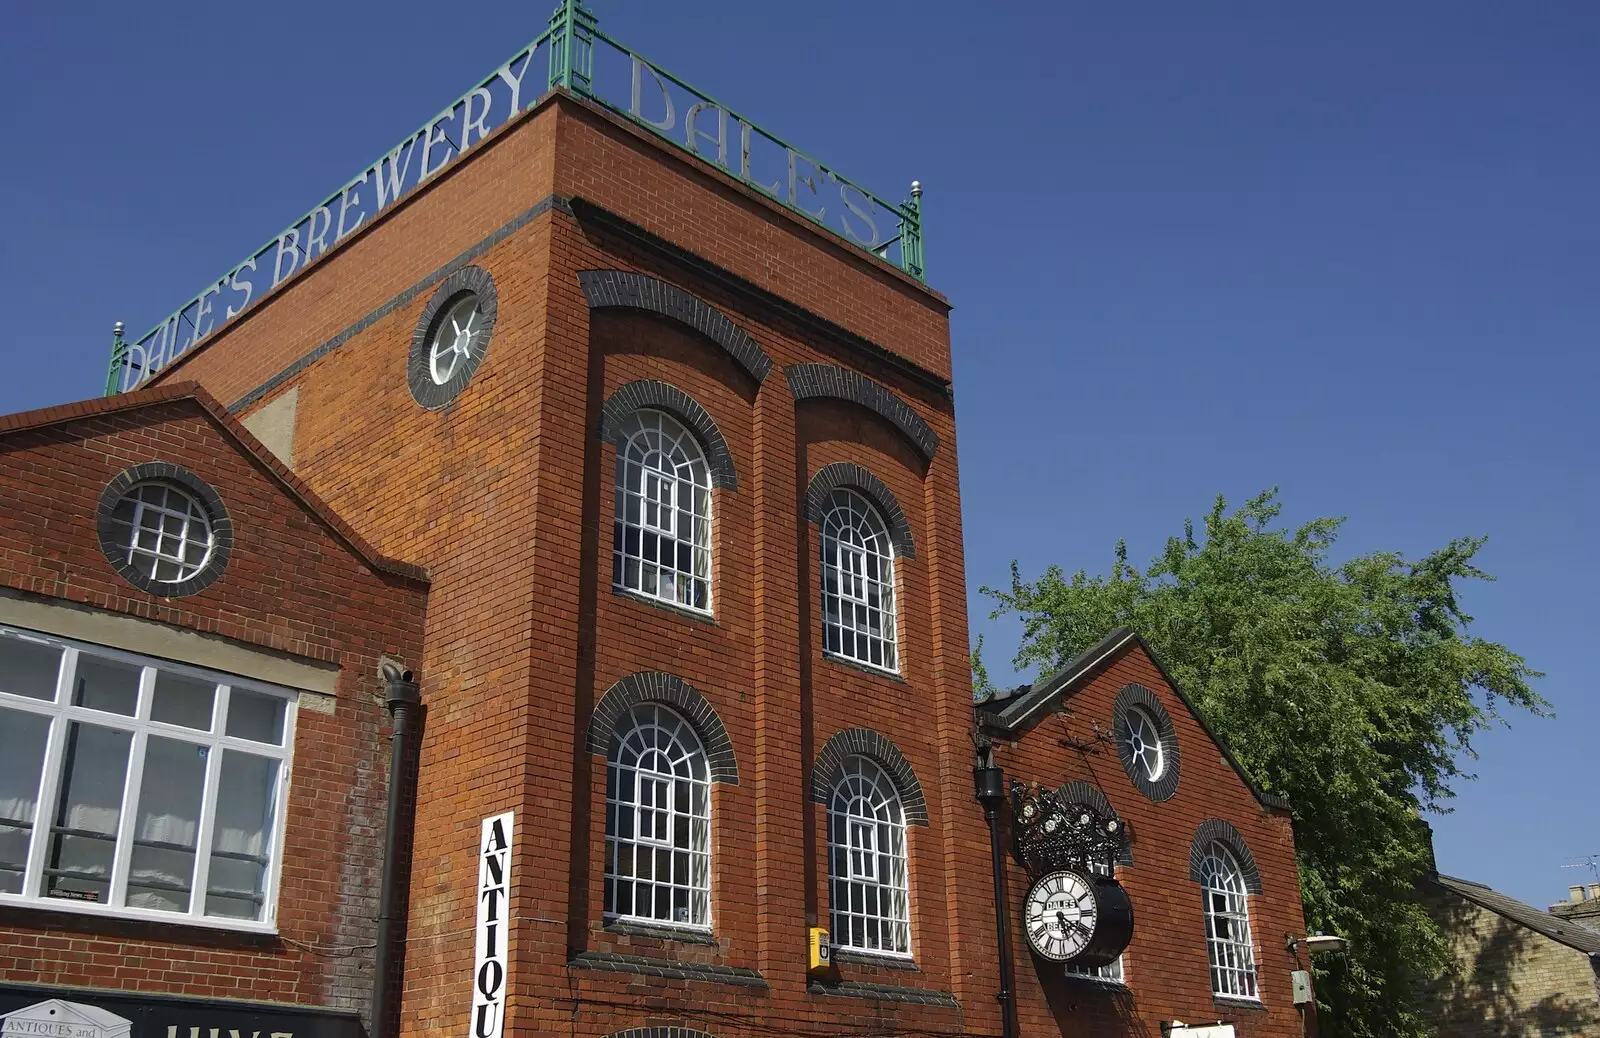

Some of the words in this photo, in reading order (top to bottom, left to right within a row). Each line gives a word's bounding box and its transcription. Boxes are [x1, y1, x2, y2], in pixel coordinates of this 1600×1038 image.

[122, 257, 256, 394] DALE'S
[270, 44, 538, 290] BREWERY
[629, 53, 880, 249] DALE'S
[475, 817, 508, 1038] ANTIQU
[1046, 899, 1076, 911] DALES
[6, 1020, 73, 1037] ANTIQUES
[76, 1028, 96, 1038] and
